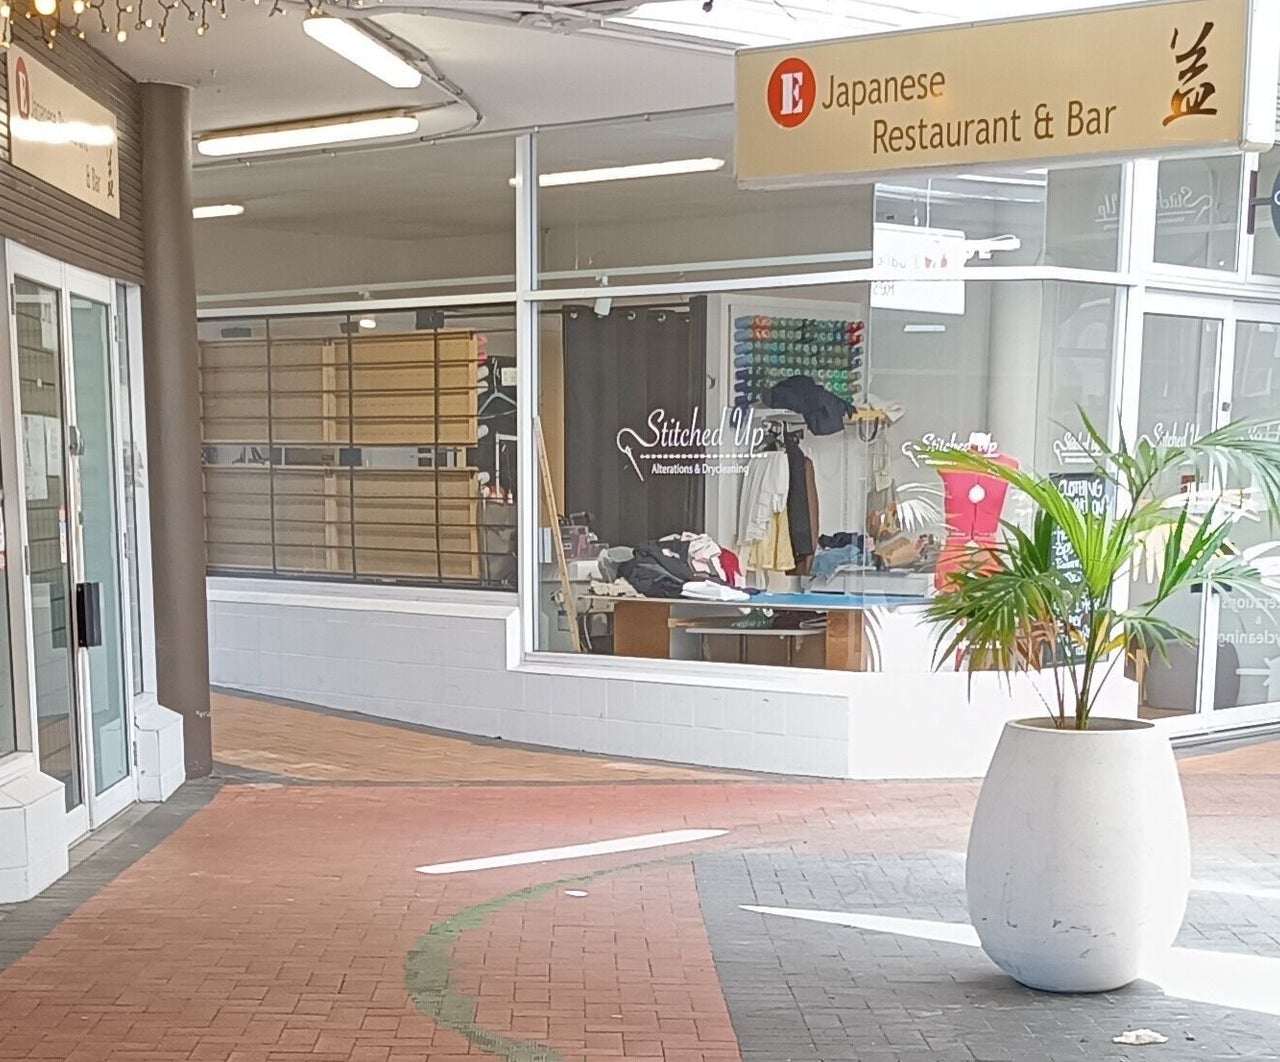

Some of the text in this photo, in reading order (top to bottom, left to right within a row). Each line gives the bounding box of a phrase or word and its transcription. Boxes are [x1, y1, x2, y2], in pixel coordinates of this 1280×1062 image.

[780, 72, 802, 115] E
[822, 70, 945, 115] Japanese
[874, 100, 1117, 154] Restaurant & Bar
[634, 406, 764, 454] Stitched Up
[652, 464, 749, 476] Alterations & Drycleaning
